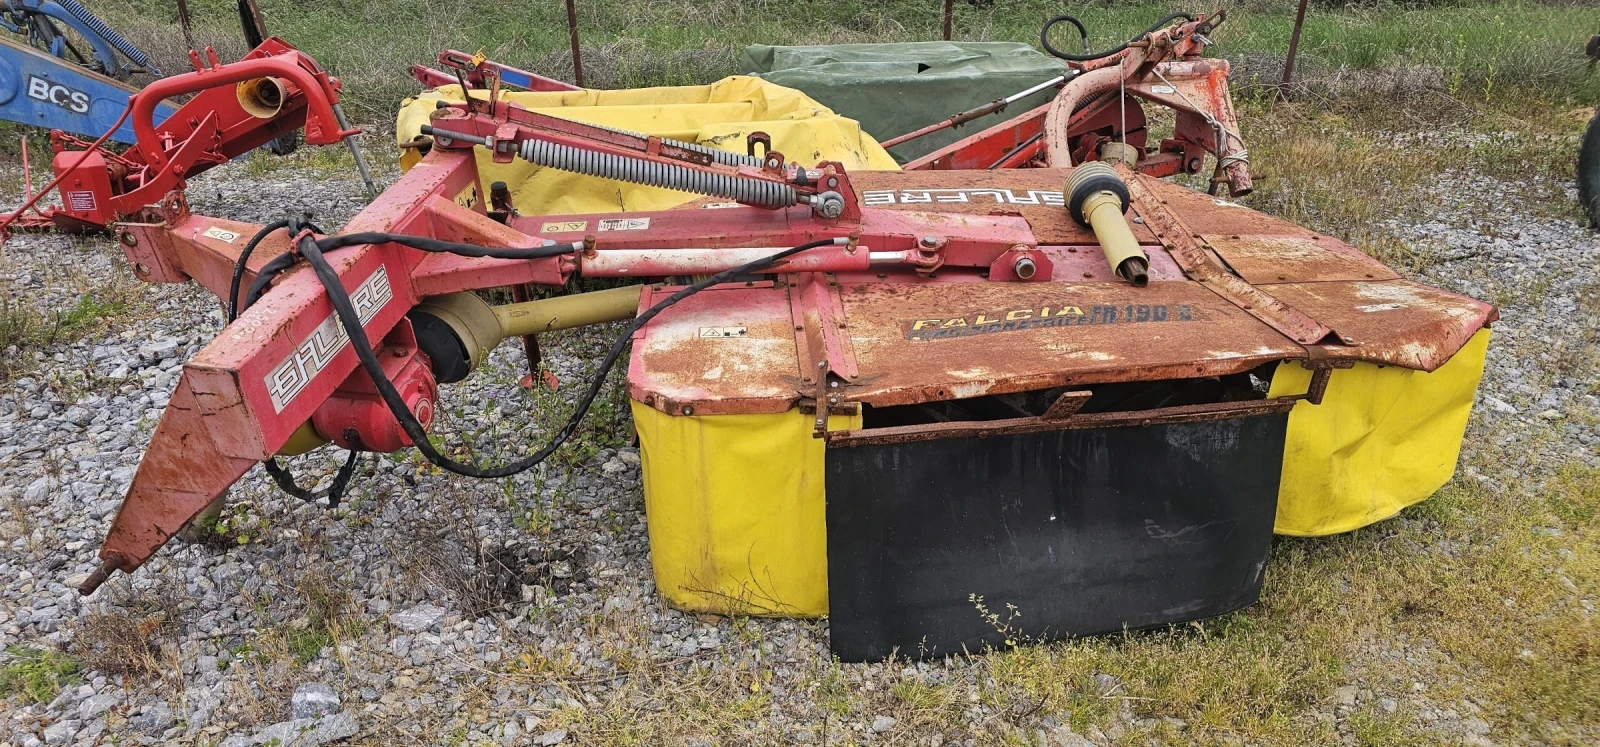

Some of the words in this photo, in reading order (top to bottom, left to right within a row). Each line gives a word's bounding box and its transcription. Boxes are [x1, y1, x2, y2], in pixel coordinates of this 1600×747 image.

[28, 76, 89, 113] BCS
[912, 305, 1085, 331] FALCIA
[1089, 304, 1117, 325] FR
[1125, 304, 1168, 322] 190
